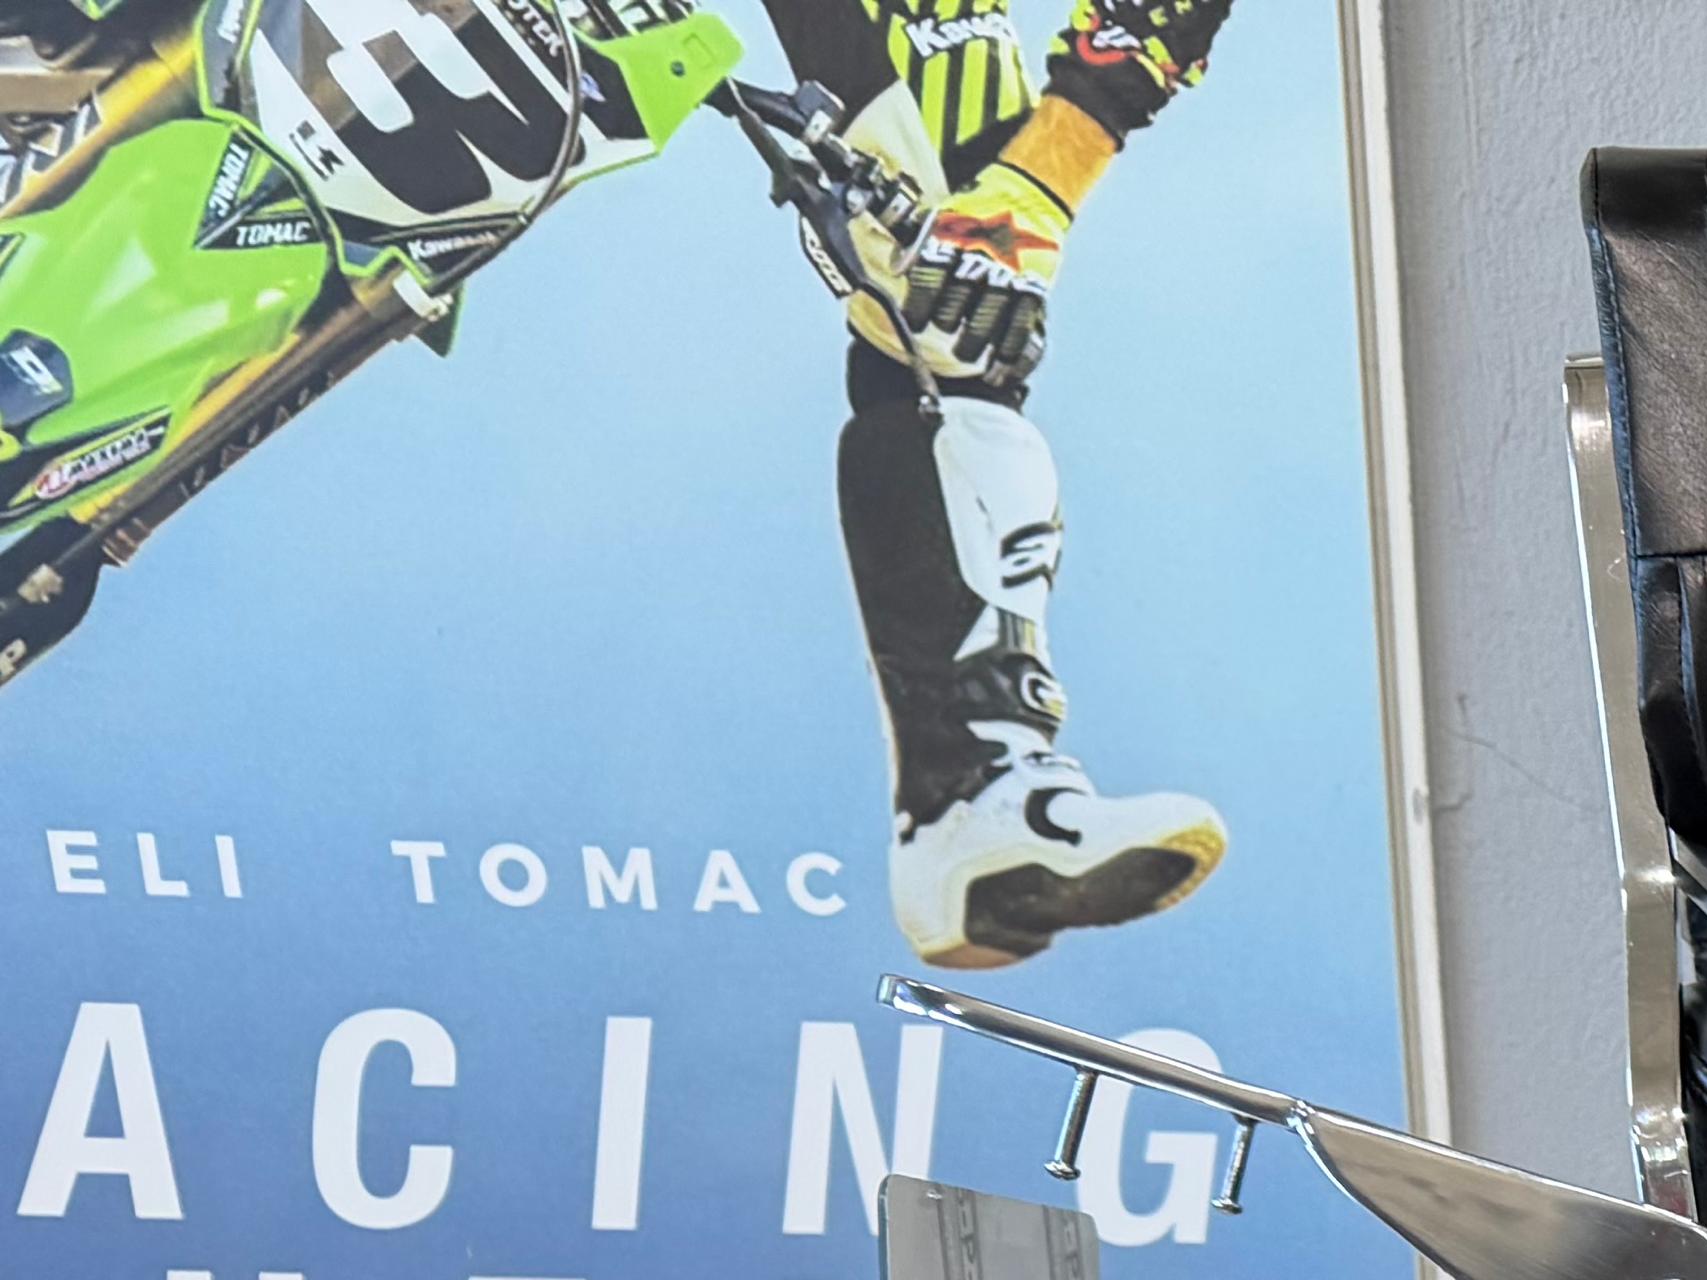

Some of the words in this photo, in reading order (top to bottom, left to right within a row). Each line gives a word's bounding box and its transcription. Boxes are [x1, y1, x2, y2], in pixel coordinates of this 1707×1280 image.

[208, 142, 250, 218] TOMAC
[235, 221, 311, 246] TOMAC
[47, 830, 242, 898] ELI
[391, 840, 846, 916] TOMAC
